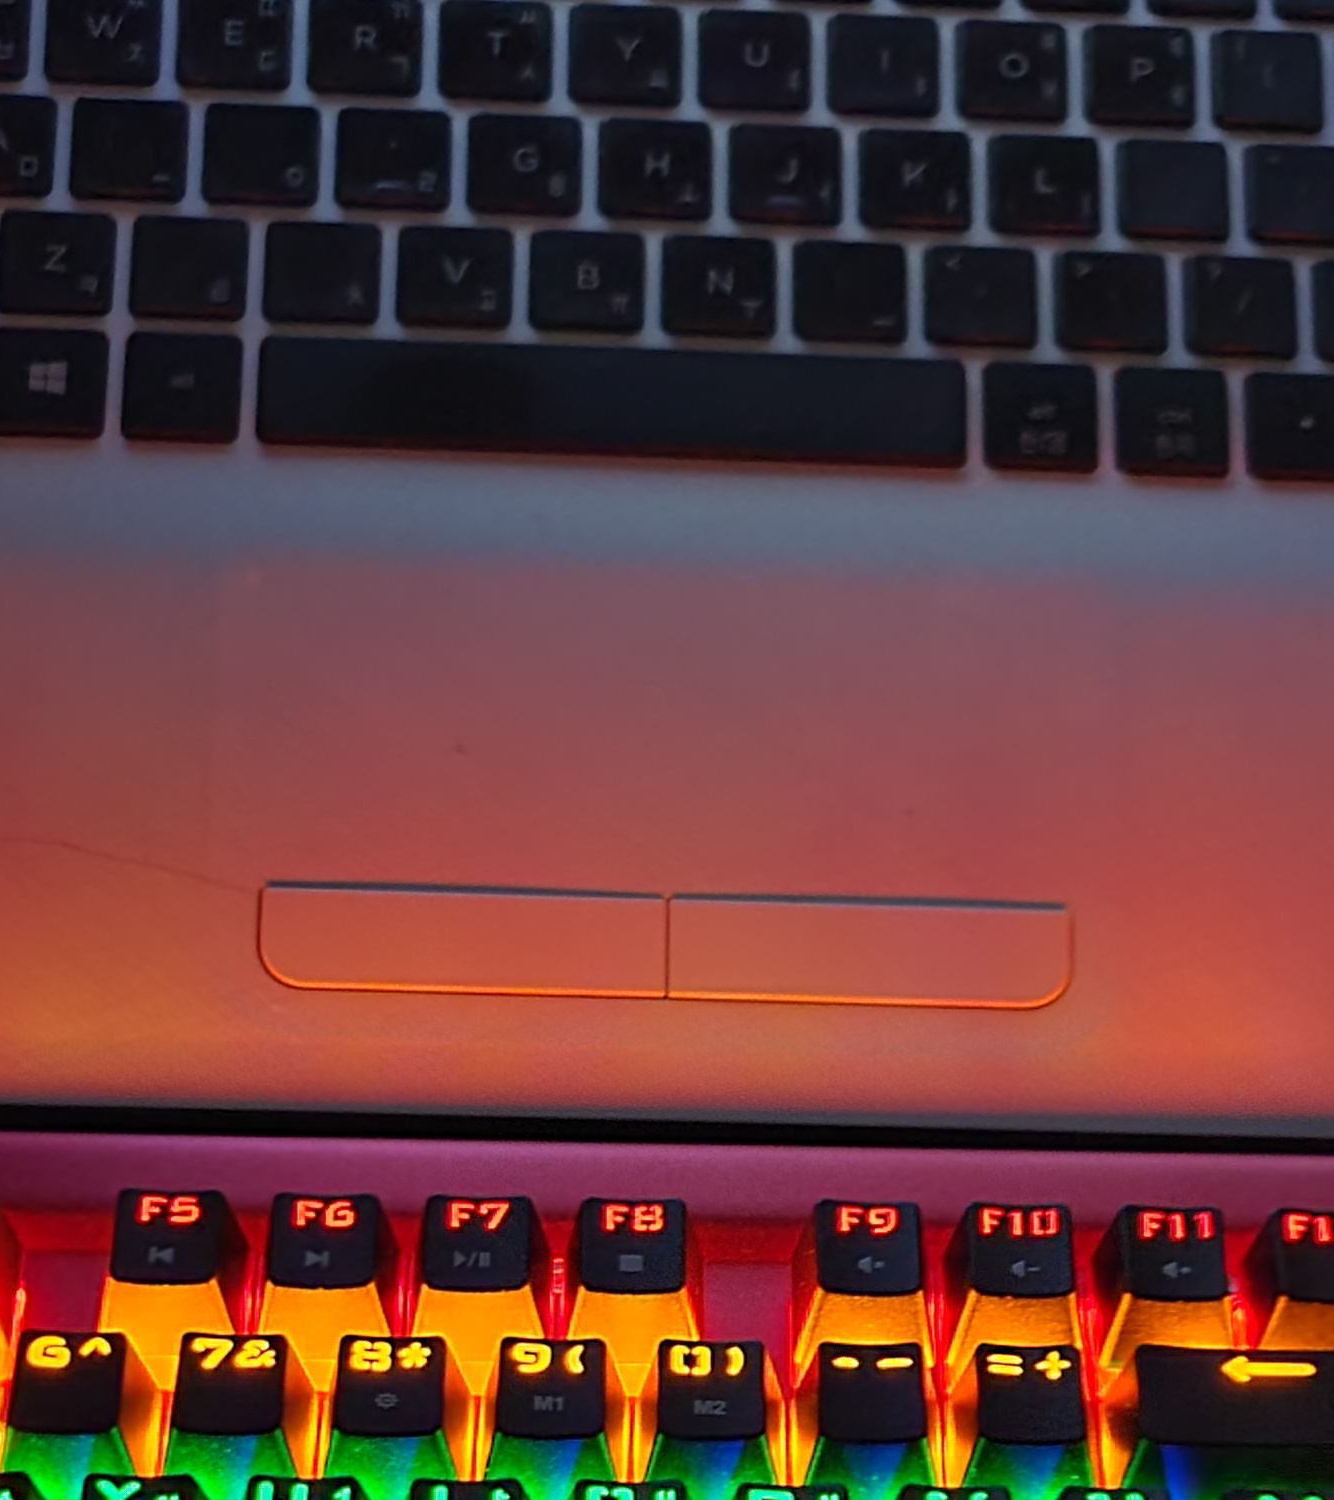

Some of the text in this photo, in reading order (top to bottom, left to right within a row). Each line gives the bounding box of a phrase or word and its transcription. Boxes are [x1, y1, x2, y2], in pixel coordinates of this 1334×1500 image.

[87, 14, 124, 39] W
[224, 20, 243, 46] E
[354, 26, 376, 52] R
[488, 32, 508, 56] T
[617, 38, 639, 60] Y
[745, 44, 768, 67] U
[1000, 51, 1029, 79] O
[1131, 57, 1152, 80] P
[514, 148, 538, 173] G
[645, 152, 668, 176] H
[779, 160, 798, 183] J
[903, 162, 926, 185] K
[1034, 168, 1057, 192] L
[45, 246, 66, 271] Z
[443, 258, 469, 283] V
[578, 262, 599, 289] B
[708, 268, 733, 294] N
[137, 1195, 202, 1223] F5
[293, 1199, 357, 1228] F6
[447, 1201, 511, 1231] F7
[602, 1204, 663, 1234] F8
[836, 1205, 899, 1234] F9
[981, 1208, 1059, 1236] F10
[1138, 1210, 1216, 1241] F11
[533, 1395, 565, 1411] M1
[693, 1400, 727, 1416] M2
